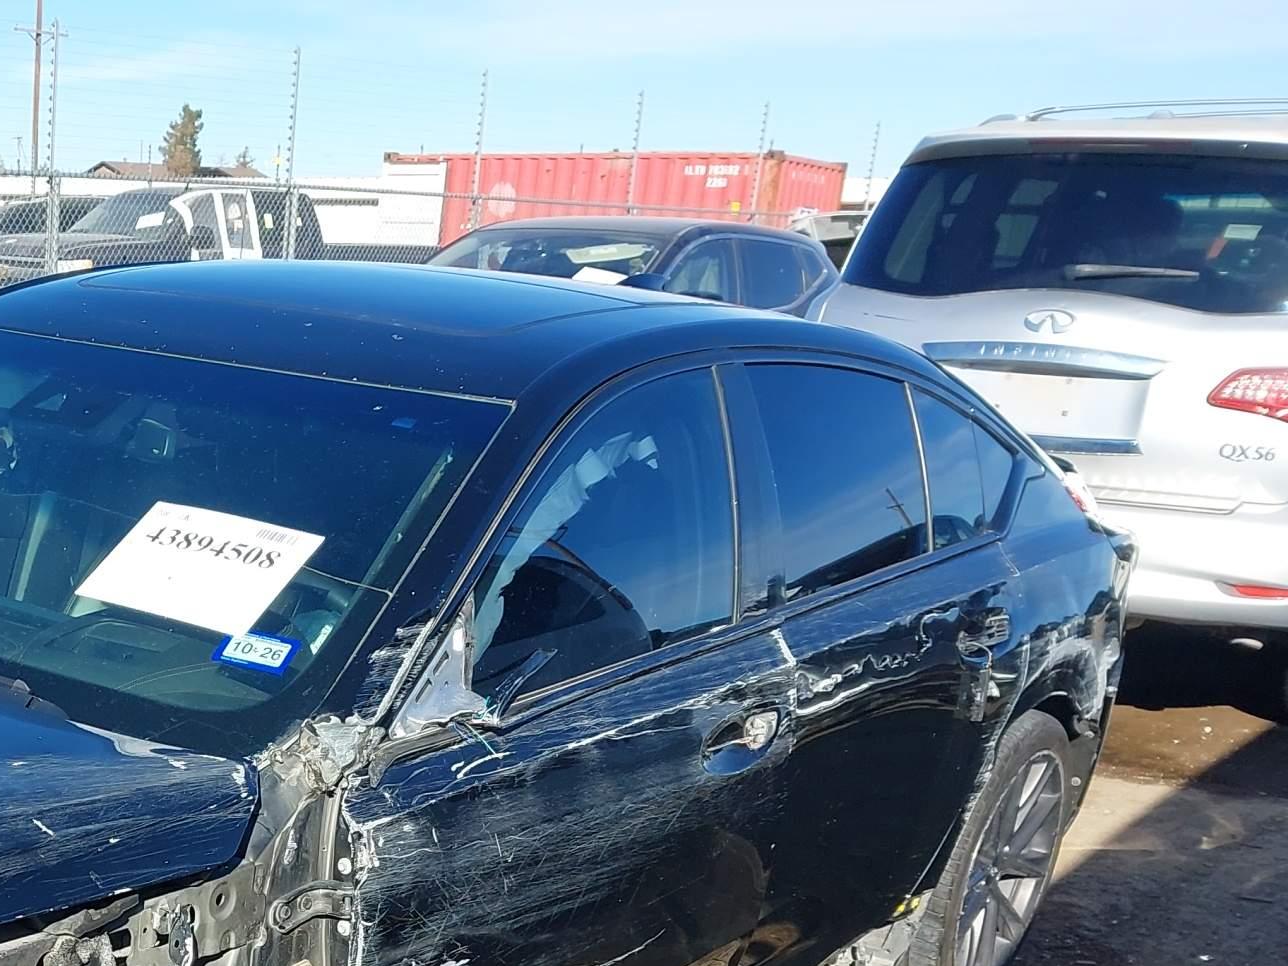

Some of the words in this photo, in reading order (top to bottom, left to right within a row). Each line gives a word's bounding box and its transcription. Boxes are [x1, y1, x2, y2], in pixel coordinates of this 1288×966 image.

[978, 343, 1096, 360] INFINI
[1219, 443, 1276, 463] QX56
[146, 525, 281, 569] 43894508
[233, 640, 254, 655] 10
[259, 647, 284, 662] 26
